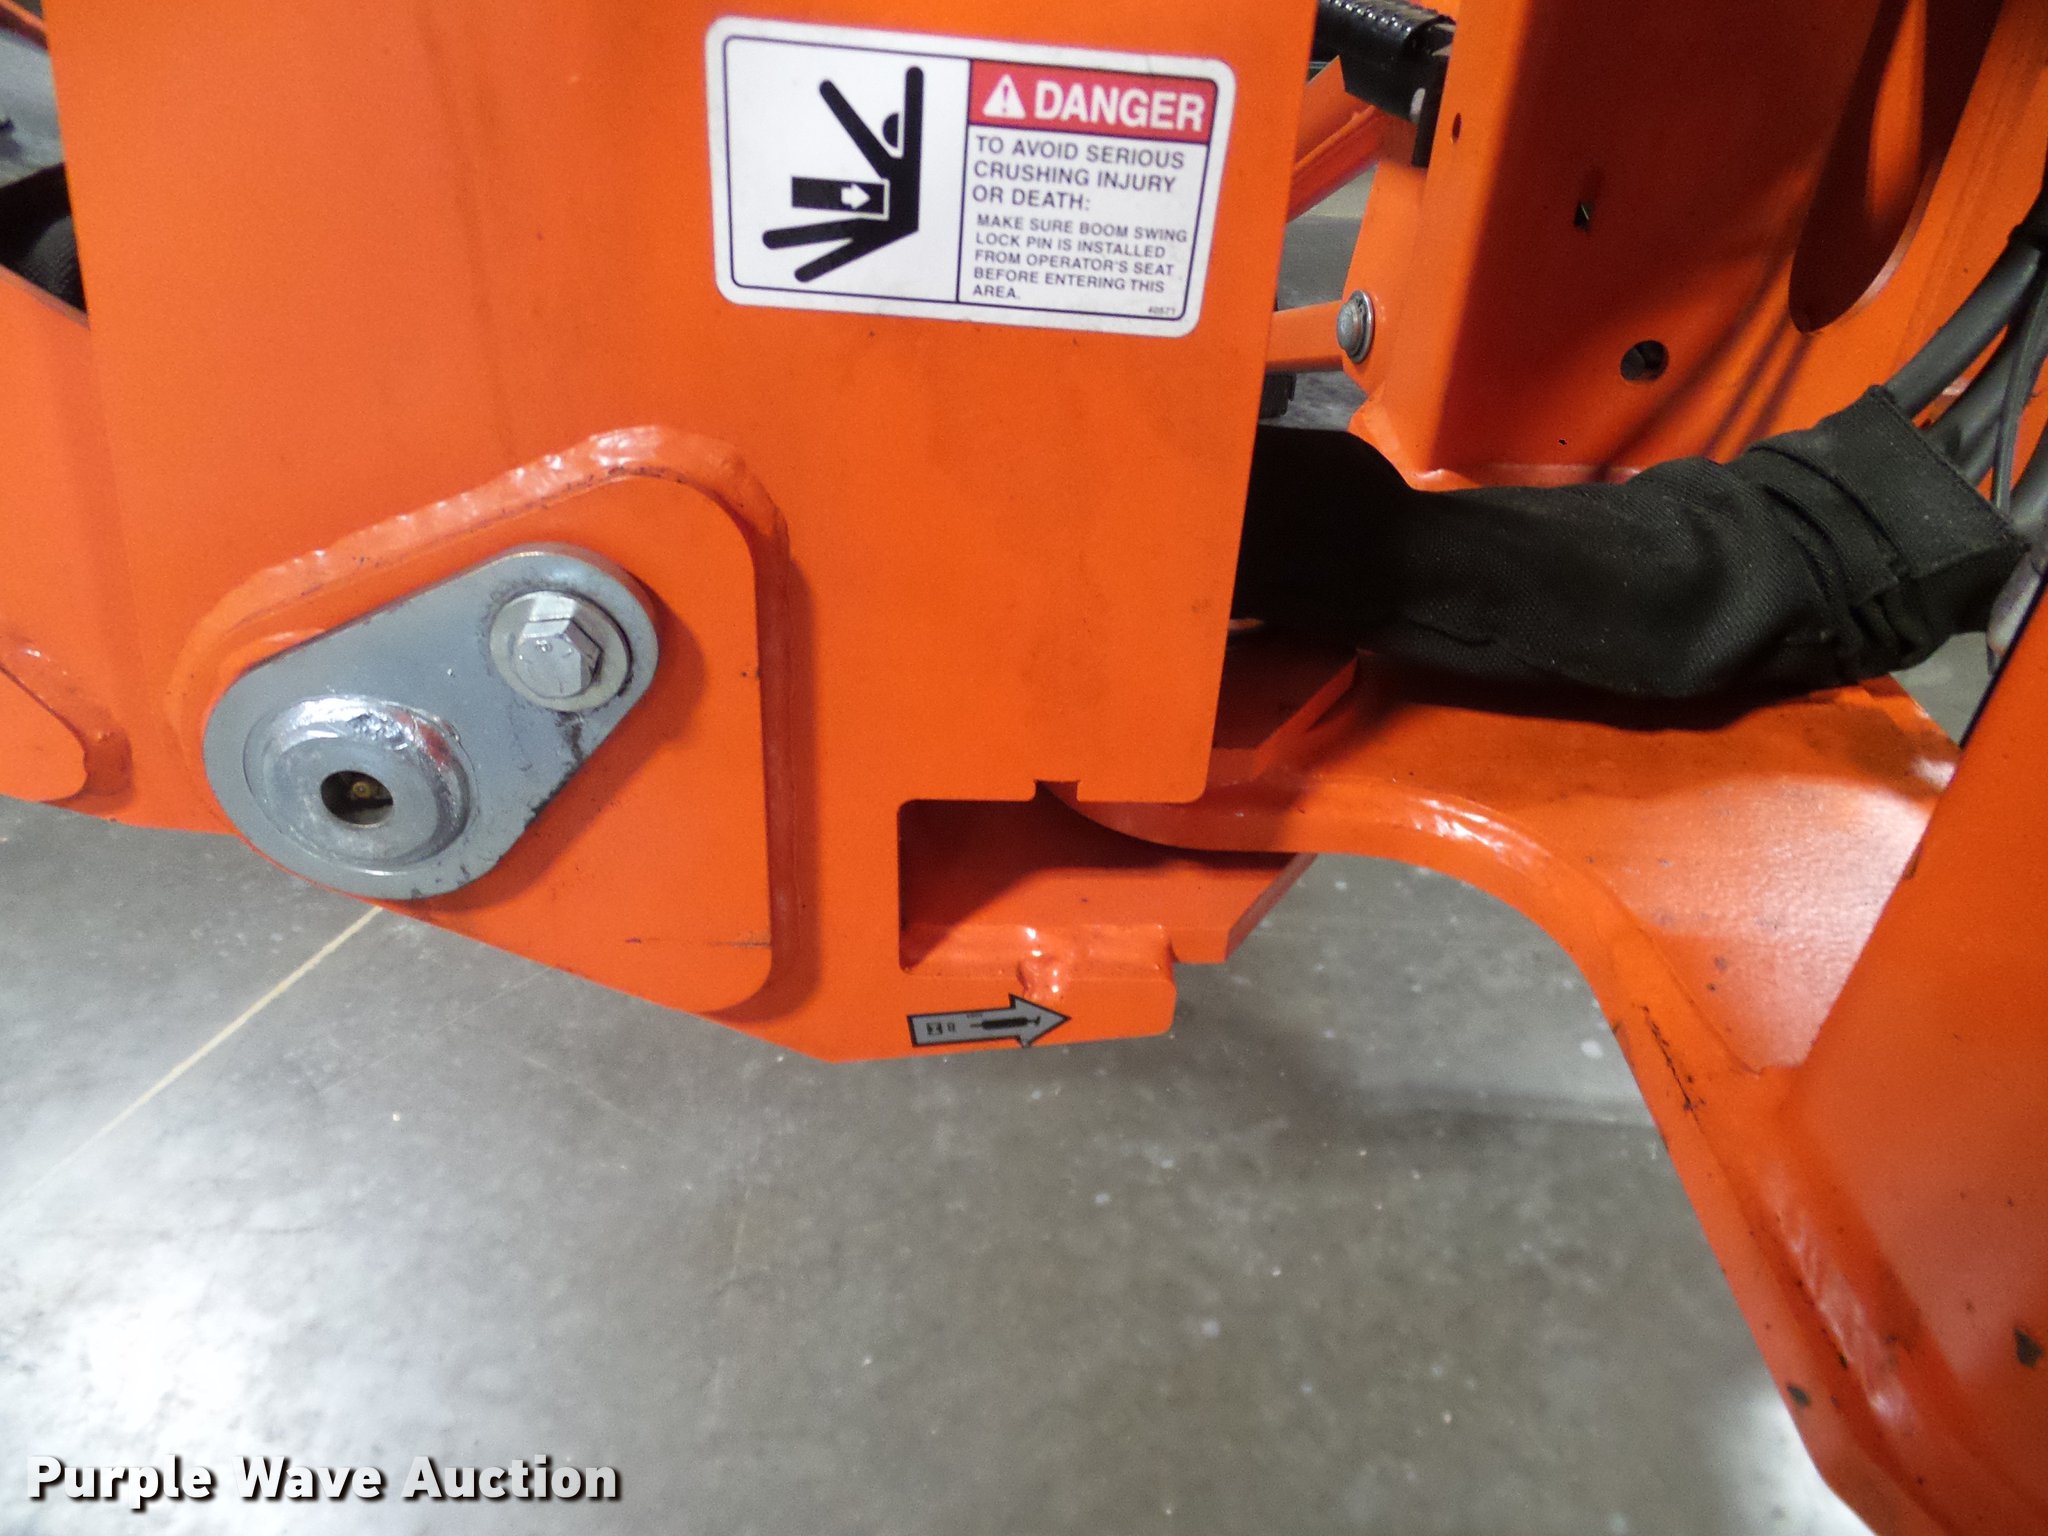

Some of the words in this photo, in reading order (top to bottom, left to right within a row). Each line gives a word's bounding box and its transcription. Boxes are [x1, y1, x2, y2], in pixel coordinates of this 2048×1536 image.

[1034, 79, 1205, 132] DANGER
[976, 135, 1004, 154] TO
[1011, 139, 1078, 161] AVOID
[1086, 144, 1184, 169] SERIOUS
[974, 160, 1089, 186] CRUSHING
[1097, 171, 1176, 193] INJURY
[972, 185, 1003, 204] OR
[1011, 189, 1091, 211] DEATH:
[977, 214, 1024, 231] MAKE
[1029, 218, 1073, 234] SURE
[1079, 222, 1128, 238] BOOM
[1134, 227, 1188, 243] SWING
[975, 232, 1020, 248] LOCK
[1026, 236, 1052, 250] PIN
[1057, 238, 1072, 251] IS
[1077, 240, 1166, 259] INSTALLED
[974, 249, 1020, 265] FROM
[1026, 253, 1128, 273] OPERATOR'S
[1133, 262, 1175, 277] SEAT
[972, 284, 1021, 300] AREA.
[973, 267, 1039, 284] BEFORE
[1044, 273, 1125, 290] ENTERING
[1130, 278, 1165, 294] THIS
